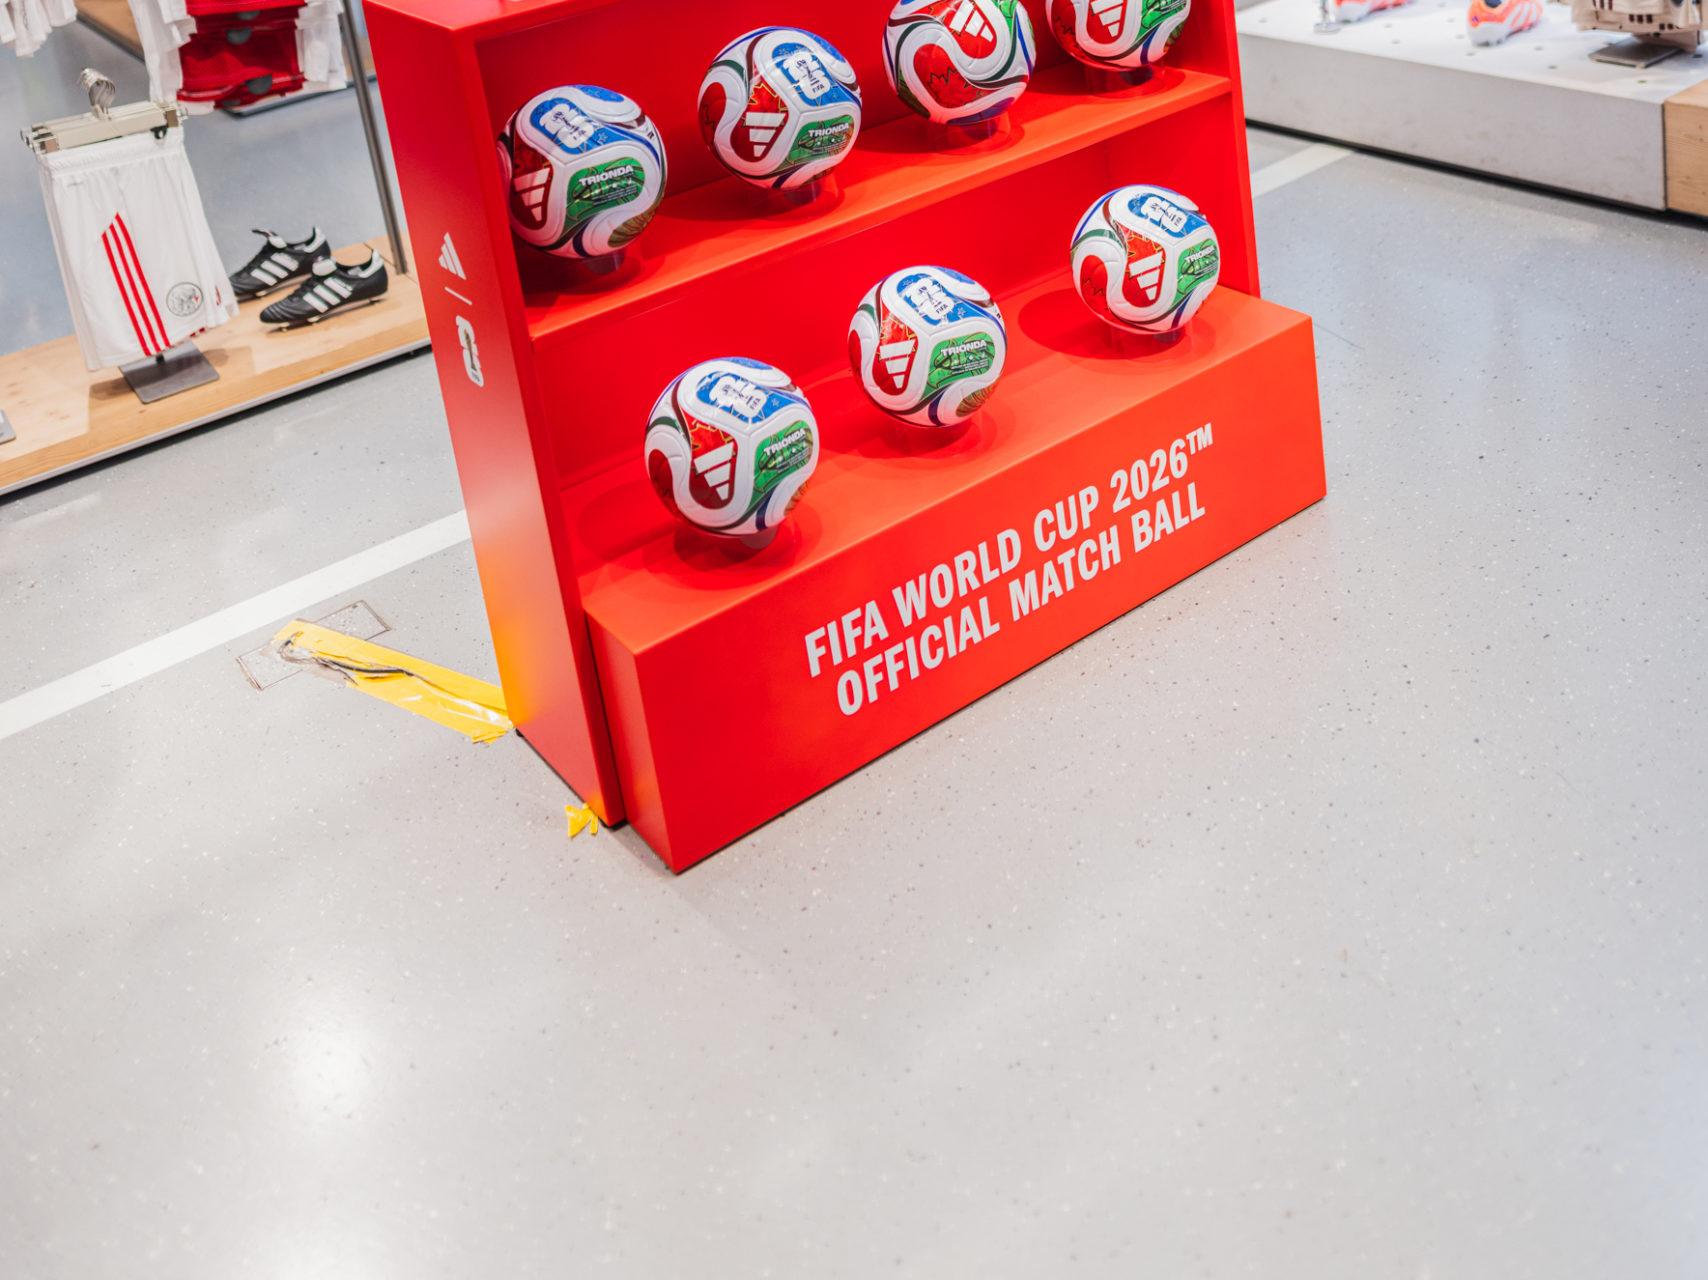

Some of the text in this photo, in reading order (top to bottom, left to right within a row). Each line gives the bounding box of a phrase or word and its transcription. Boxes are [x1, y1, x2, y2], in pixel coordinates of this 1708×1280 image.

[808, 122, 850, 138] TRIONDA
[578, 164, 635, 187] TRIONDA
[940, 340, 987, 357] TRIONDA
[763, 428, 806, 456] TRIONDA
[804, 600, 890, 678] FIFA
[891, 528, 1022, 628] WORLD
[1033, 485, 1100, 552] CUP
[837, 482, 1206, 716] OFFICIAL MATCH BALL
